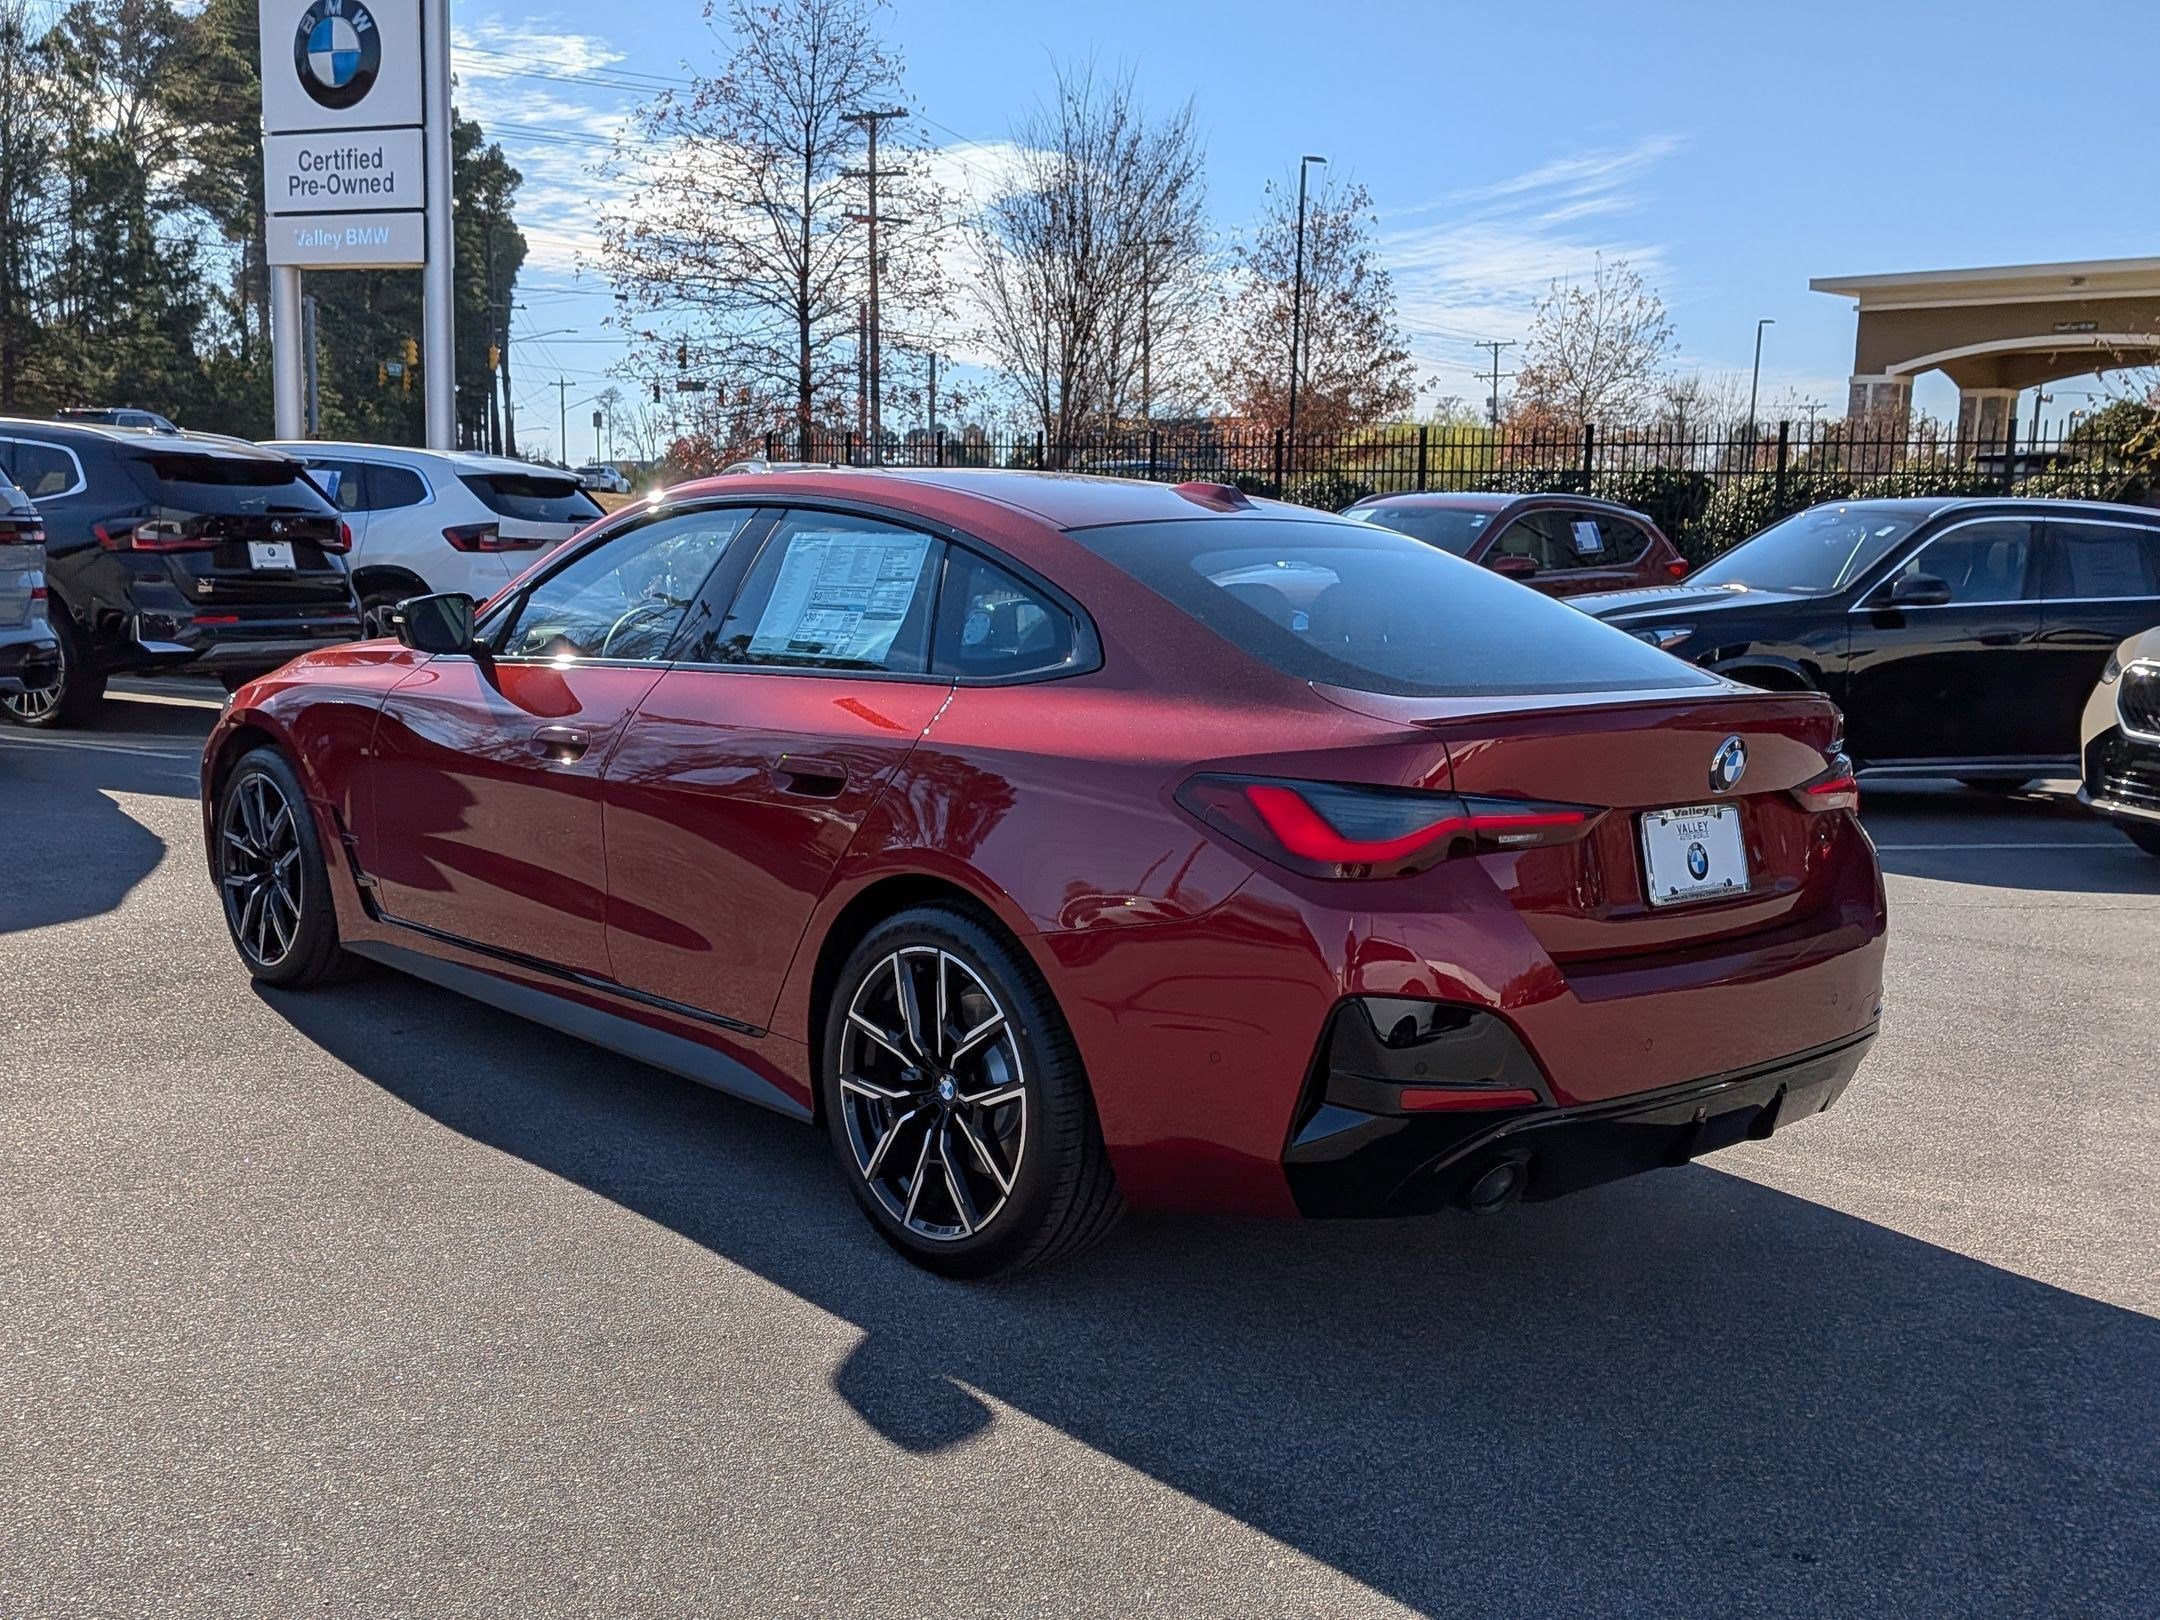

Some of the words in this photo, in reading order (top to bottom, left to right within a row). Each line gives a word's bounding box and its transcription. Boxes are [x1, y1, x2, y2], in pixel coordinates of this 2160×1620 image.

[299, 0, 372, 35] BMW
[298, 147, 384, 172] Certified
[288, 171, 395, 197] Pre-Owned
[294, 229, 346, 249] Valley
[346, 227, 390, 246] BMW
[1672, 807, 1710, 817] Valley
[1675, 821, 1709, 835] VALLEY
